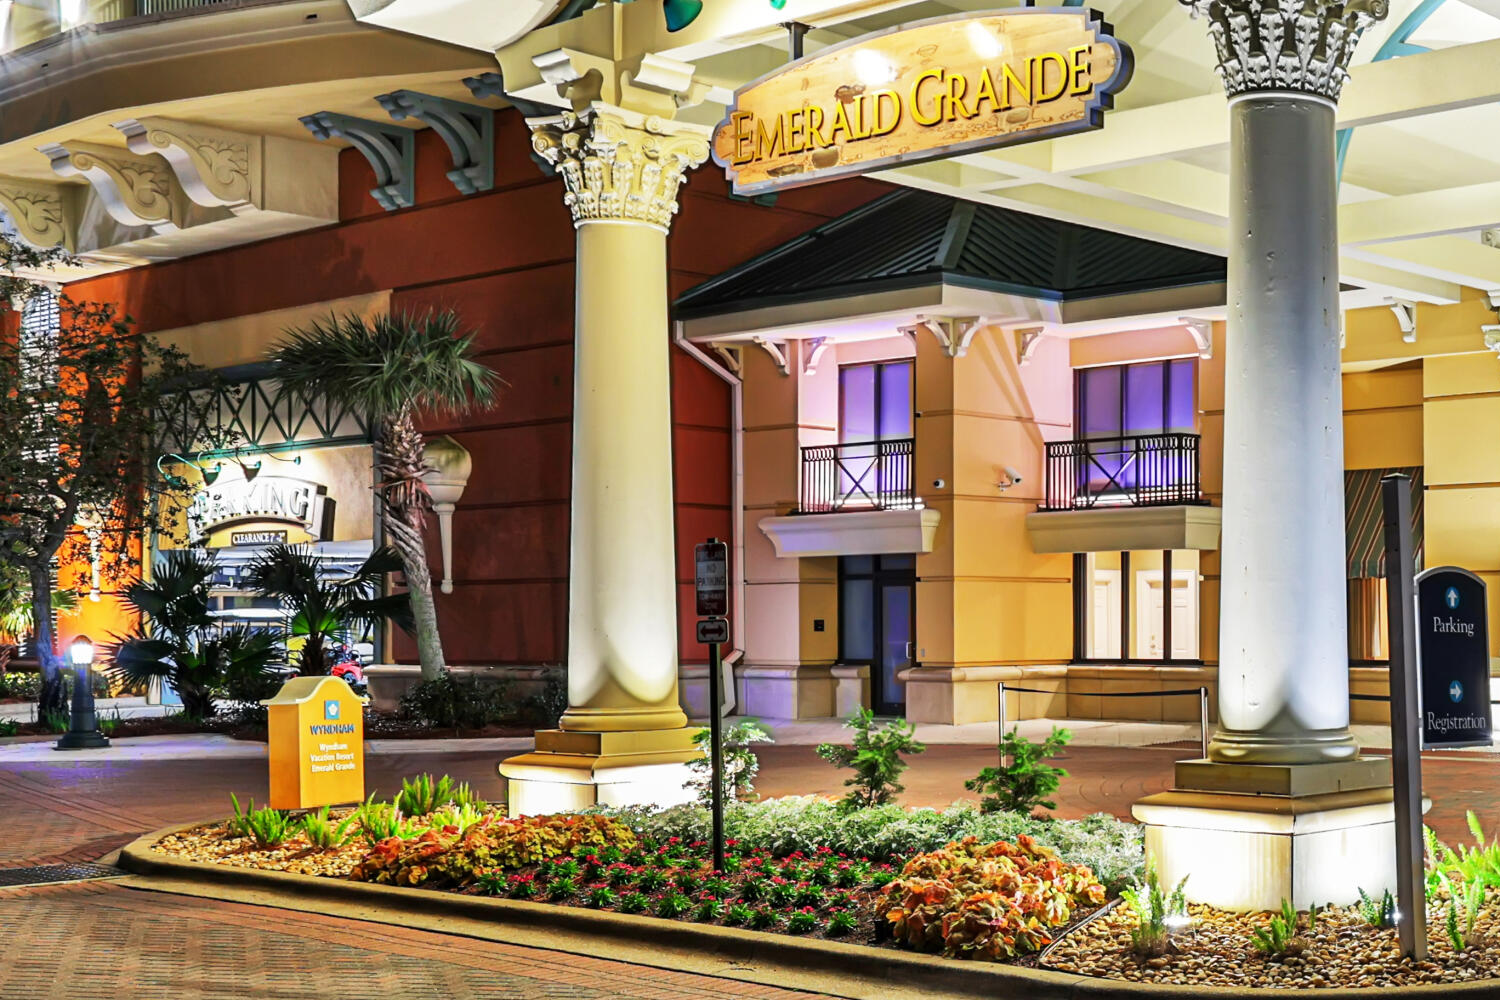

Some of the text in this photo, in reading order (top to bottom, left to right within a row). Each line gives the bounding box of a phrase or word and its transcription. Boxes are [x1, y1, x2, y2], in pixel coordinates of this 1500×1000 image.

[732, 44, 1094, 166] EMERALD GRANDE
[232, 532, 270, 544] CLEARANCE
[1433, 616, 1475, 638] Parking
[310, 724, 355, 735] WYNDHAM
[1427, 711, 1486, 734] Registration
[311, 763, 334, 773] Emerald
